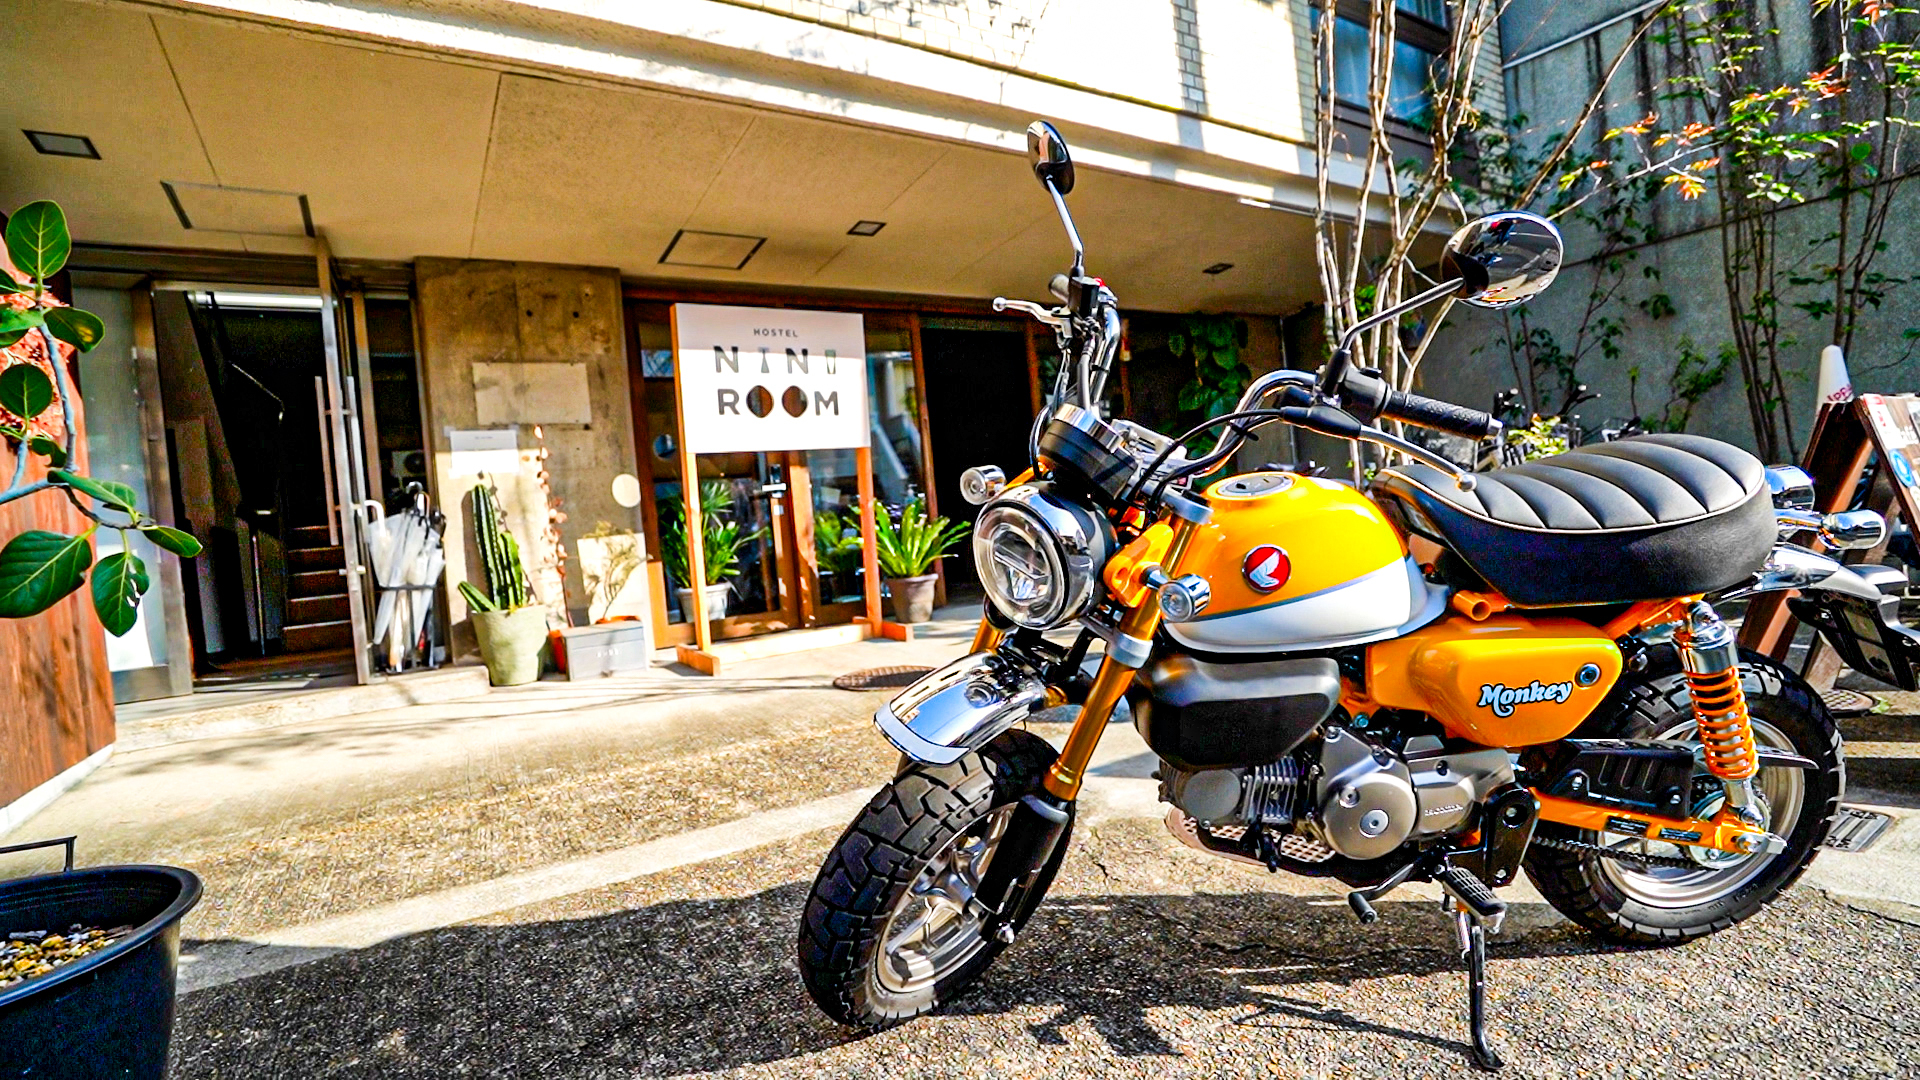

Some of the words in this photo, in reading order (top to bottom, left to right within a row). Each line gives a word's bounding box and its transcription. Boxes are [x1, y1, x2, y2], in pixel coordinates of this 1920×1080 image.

[753, 328, 799, 338] HOSTEL
[713, 345, 836, 375] NINI
[717, 384, 839, 418] ROOM
[1477, 679, 1573, 718] Monkey
